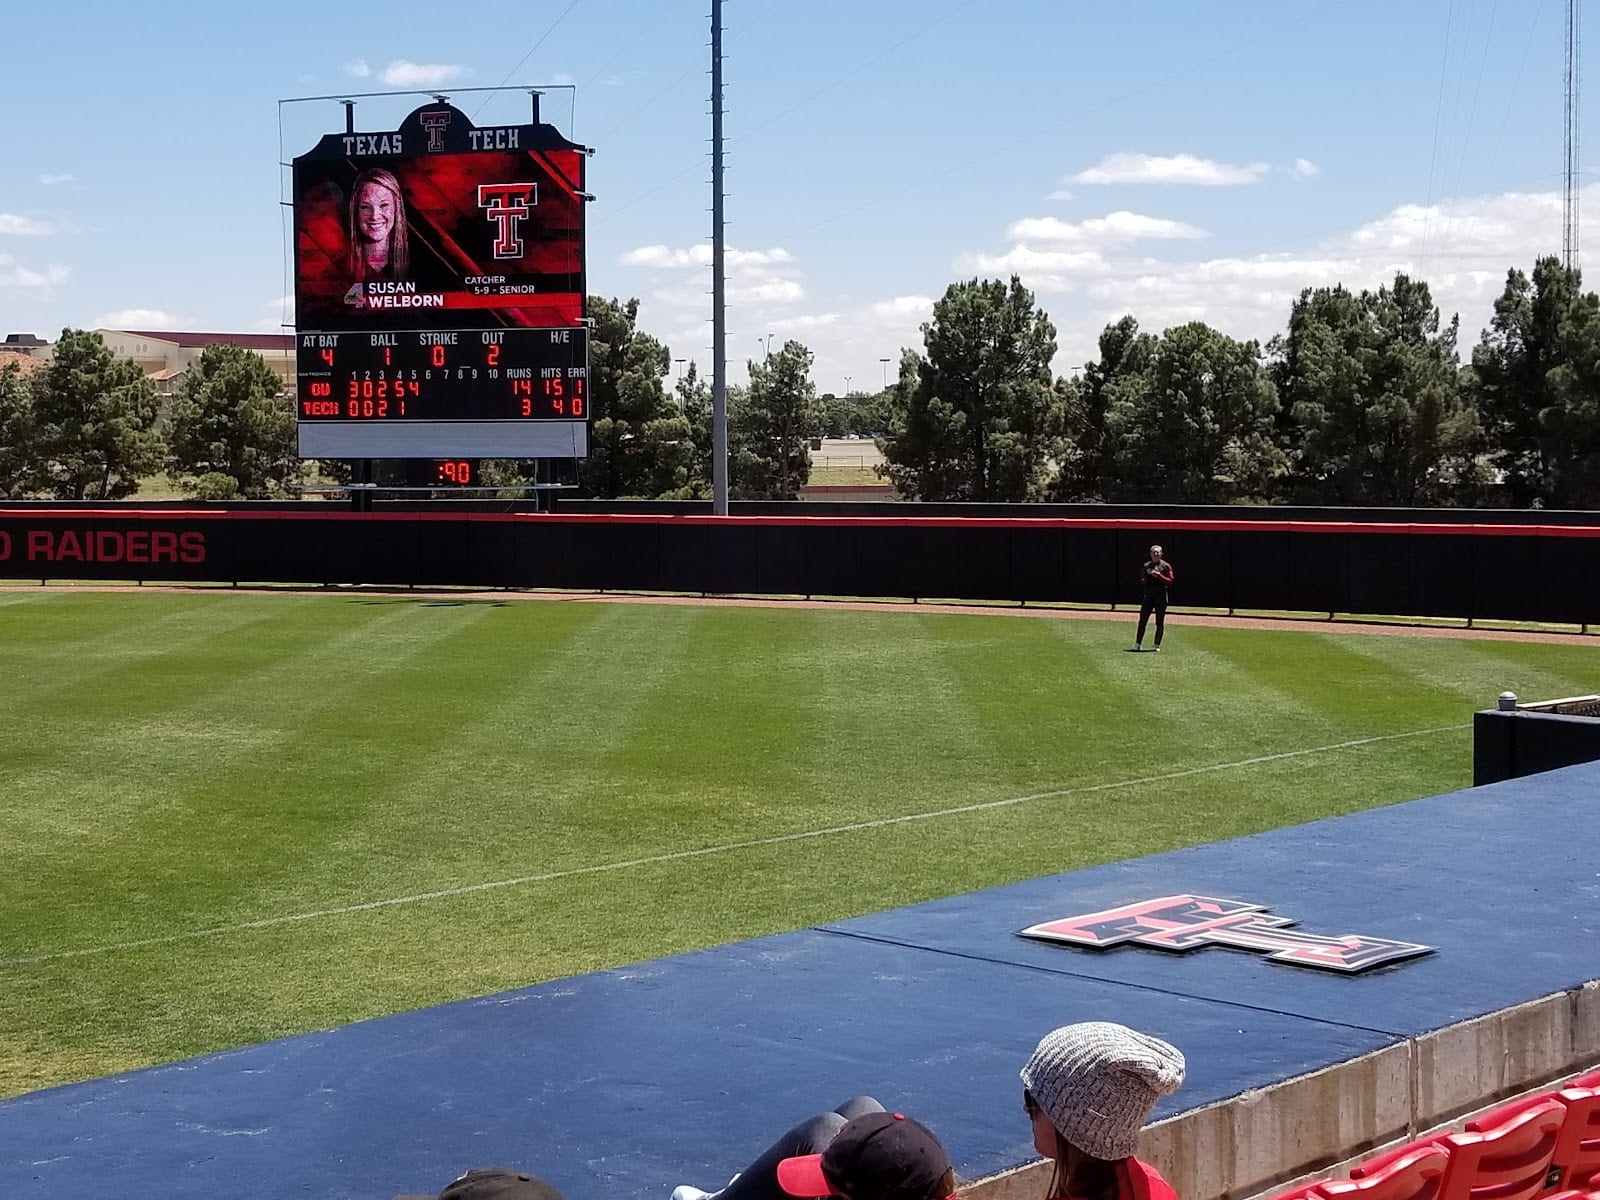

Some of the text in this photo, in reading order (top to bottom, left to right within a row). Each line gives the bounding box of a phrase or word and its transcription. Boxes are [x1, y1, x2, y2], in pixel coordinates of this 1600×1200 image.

[343, 134, 402, 156] TEXAS
[469, 128, 519, 150] TECH
[465, 275, 506, 285] CATCHER
[368, 281, 416, 294] SUSAN
[474, 286, 490, 295] 5-9
[499, 285, 535, 294] SENIOR
[369, 294, 444, 308] WELBORN
[303, 335, 339, 347] AT BAT
[371, 334, 398, 346] BALL
[420, 332, 458, 346] STRIKE
[482, 332, 504, 345] OUT
[551, 331, 570, 344] H/E
[321, 348, 334, 367] 4
[384, 347, 391, 366] 1
[432, 346, 445, 366] 0
[487, 345, 500, 366] 2
[351, 369, 498, 380] 1 2 3 4 5 6 7 8 9 10
[507, 368, 532, 379] RUNS
[541, 368, 562, 378] HITS
[568, 367, 586, 378] ERR
[350, 381, 419, 398] 3 0 2 5 4
[512, 380, 531, 395] 14
[545, 379, 563, 395] 15
[303, 401, 339, 415] TECH
[349, 400, 359, 417] 0
[363, 401, 373, 417] 0
[378, 401, 387, 416] 2
[521, 398, 532, 415] 3
[552, 399, 563, 414] 4
[572, 398, 582, 415] 0
[28, 530, 206, 563] RAIDERS
